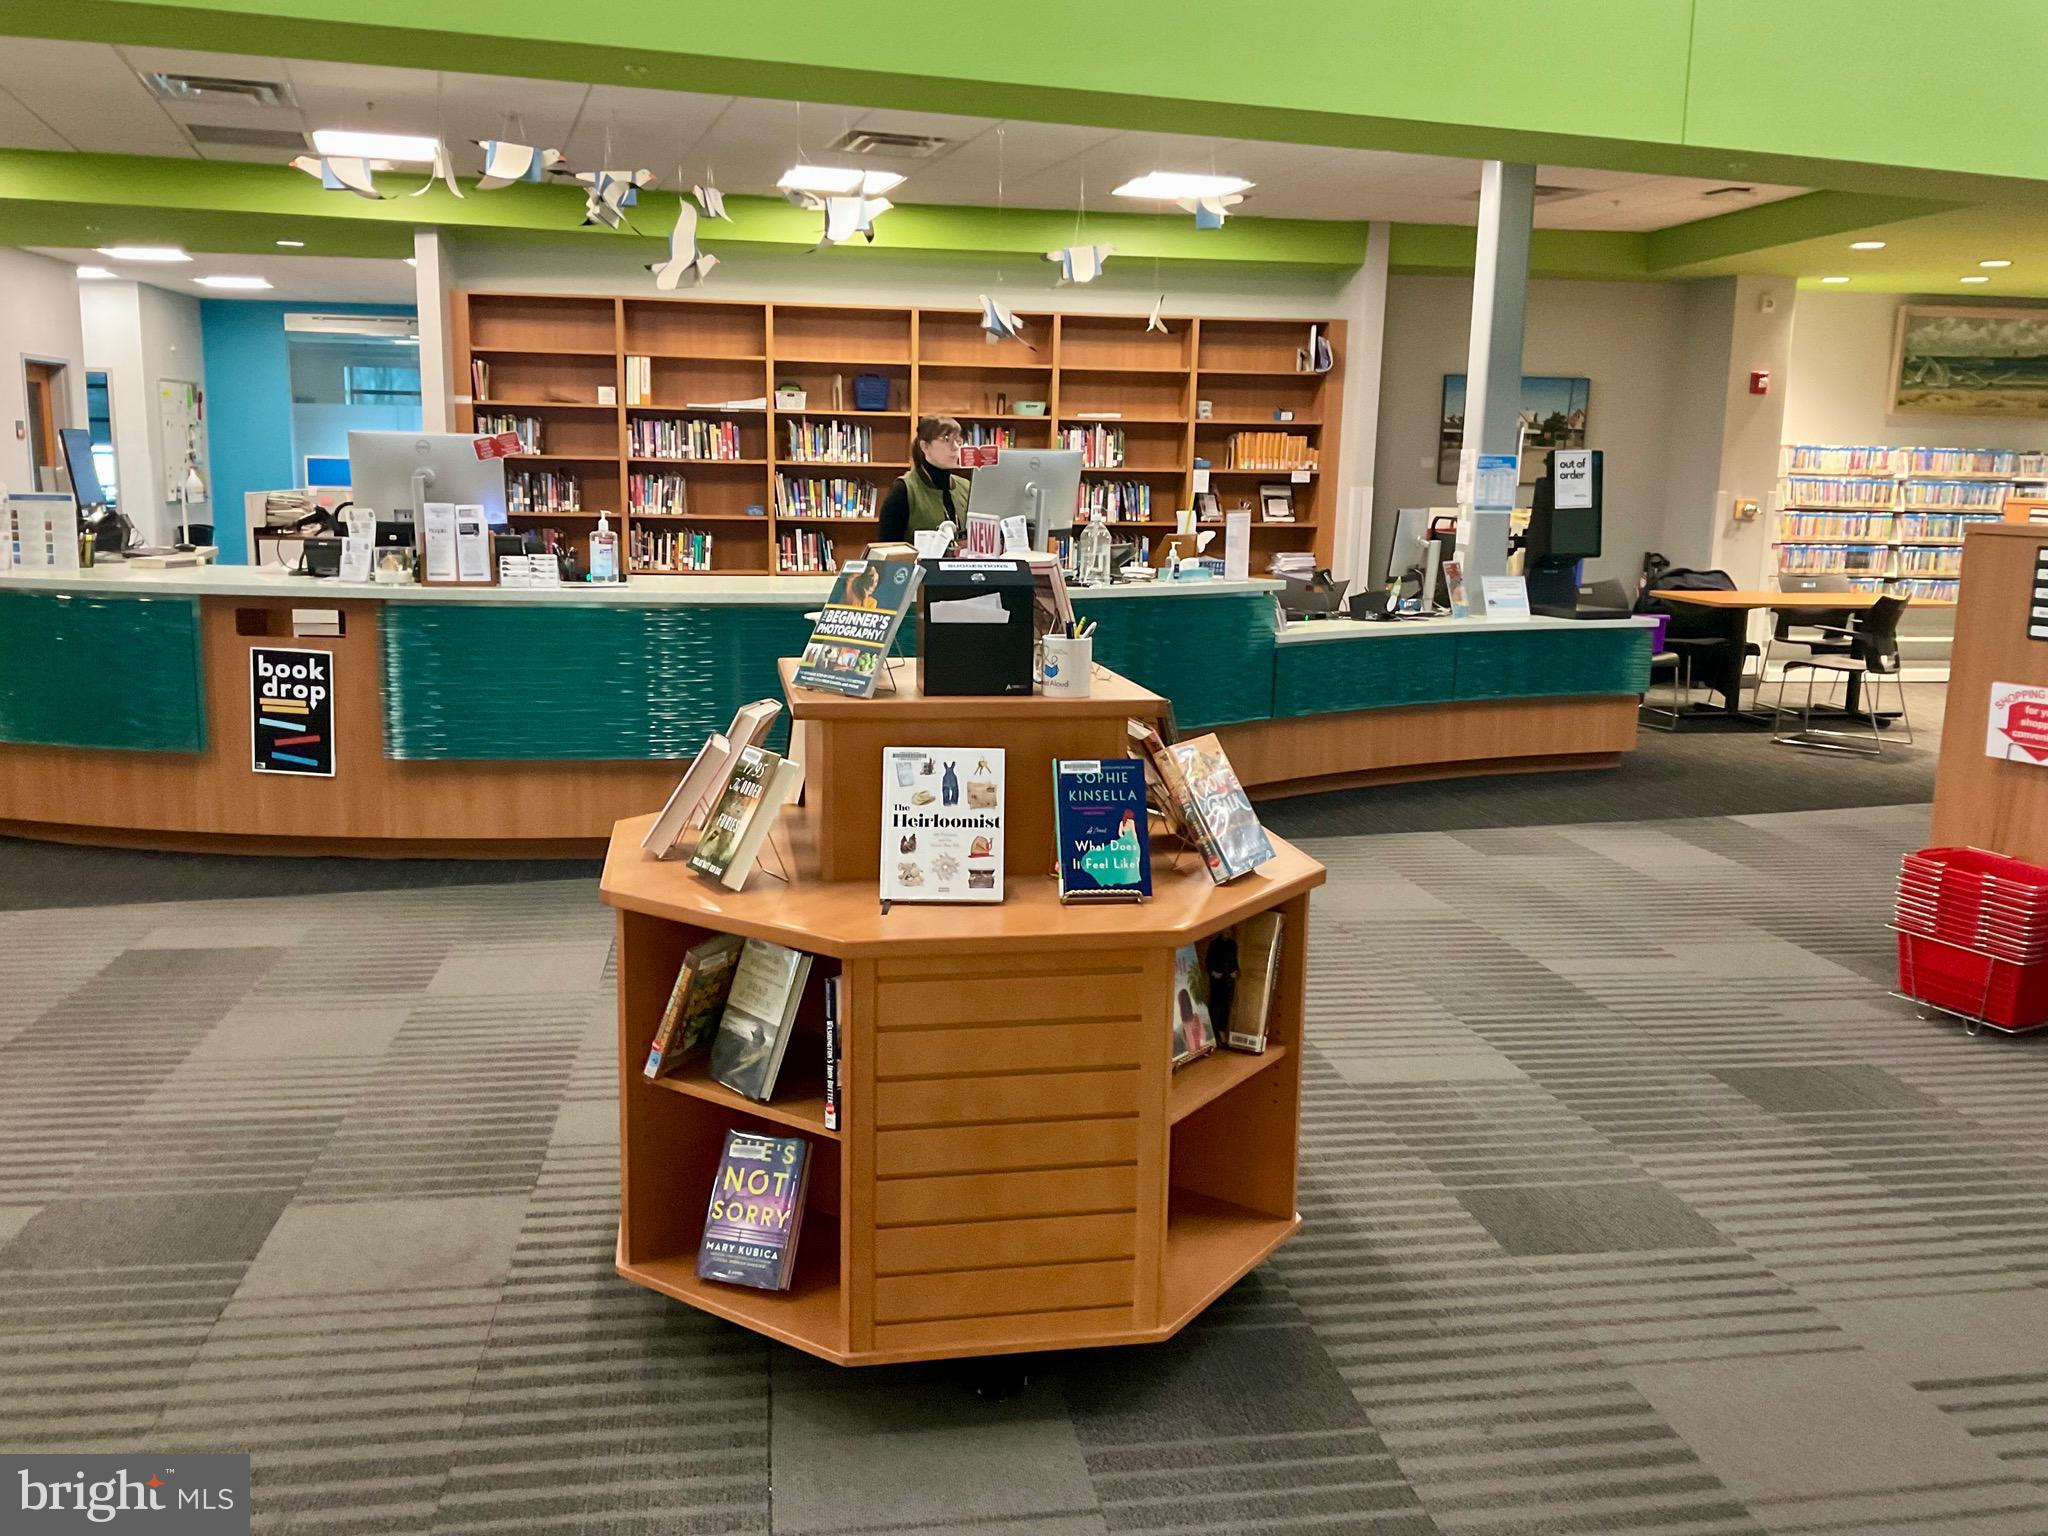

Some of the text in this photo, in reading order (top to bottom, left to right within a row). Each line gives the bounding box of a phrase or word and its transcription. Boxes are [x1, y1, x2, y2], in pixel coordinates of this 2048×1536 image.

[1559, 457, 1586, 469] out of
[1559, 469, 1586, 480] order
[969, 521, 996, 555] NEW
[827, 609, 891, 630] BEGINNER'S
[816, 622, 882, 641] PHOTOGRAPHY
[257, 654, 325, 680] book
[262, 674, 326, 710] drop
[1994, 689, 2046, 710] SHOPPING
[2025, 704, 2039, 715] for
[1076, 771, 1129, 784] SOPHIE
[1069, 790, 1138, 801] KINSELLA
[893, 803, 911, 811] The
[893, 813, 1000, 829] Heirloomist
[1075, 840, 1137, 852] What Does
[1085, 858, 1109, 869] Feel
[723, 1165, 789, 1197] NOT
[711, 1199, 791, 1229] SORRY
[706, 1241, 736, 1253] MARY
[738, 1245, 779, 1260] KUBICA
